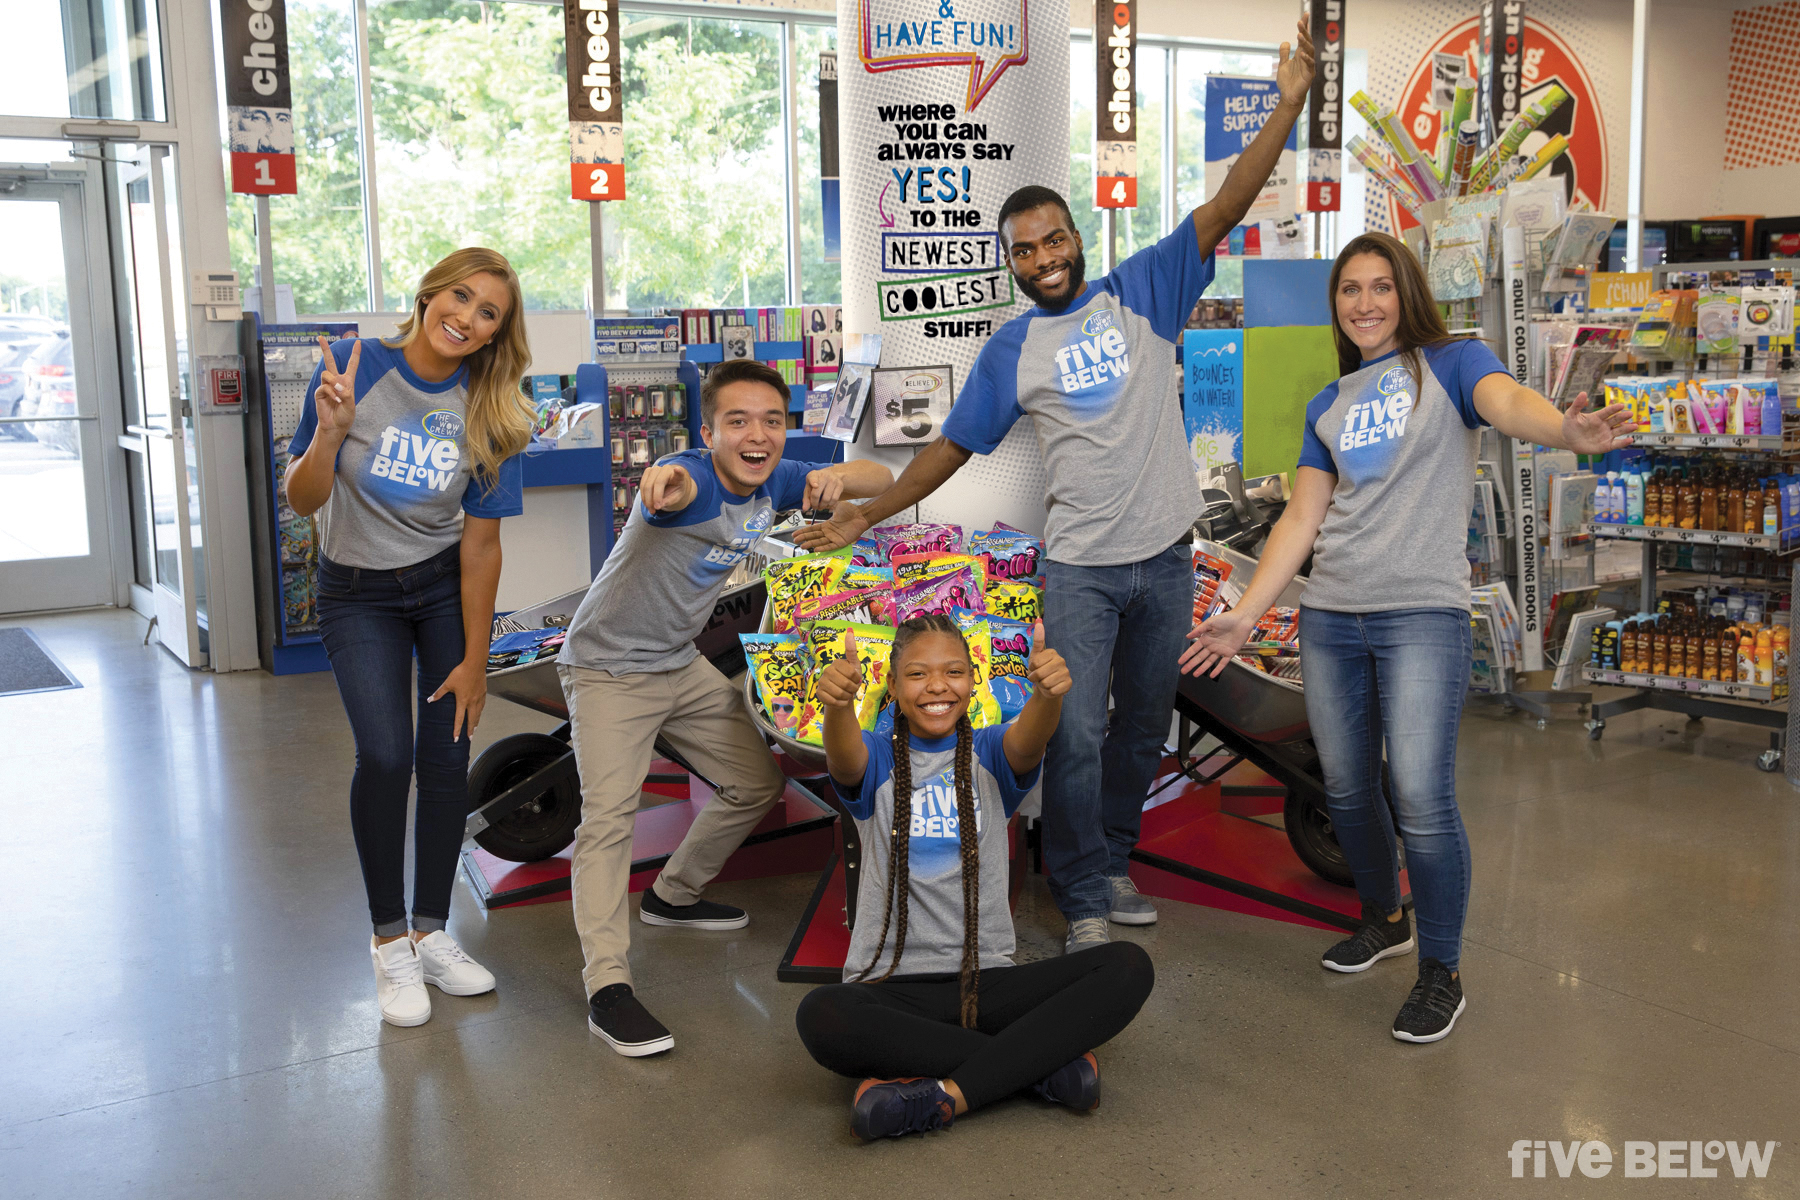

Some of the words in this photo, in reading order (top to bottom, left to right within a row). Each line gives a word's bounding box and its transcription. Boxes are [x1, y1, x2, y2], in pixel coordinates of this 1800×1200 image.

[876, 21, 943, 49] HAVE
[953, 21, 1014, 49] FUN!
[1108, 0, 1131, 133] checko
[1319, 0, 1341, 141] checkou
[1498, 1, 1521, 130] heckout
[1224, 95, 1260, 114] HELP
[1262, 93, 1280, 110] US
[1223, 111, 1273, 132] SUPPO
[255, 159, 276, 186] 1
[590, 169, 609, 194] 2
[892, 165, 971, 204] YES!
[1111, 181, 1127, 203] 4
[1319, 186, 1332, 206] 5
[910, 210, 936, 227] TO
[892, 241, 991, 265] NEWEST
[886, 276, 1000, 313] COOLEST
[1089, 313, 1102, 325] THE
[1095, 314, 1111, 326] WOW
[727, 340, 747, 358] $3
[1055, 328, 1126, 375] five
[1515, 325, 1528, 388] COLORiN
[217, 371, 238, 379] FIRE
[1061, 354, 1130, 393] BELOW
[1192, 363, 1234, 385] BOUNCES
[1387, 370, 1400, 378] THE
[836, 376, 863, 430] $1
[1192, 388, 1205, 407] ON
[1206, 388, 1235, 408] WATER!
[434, 413, 450, 422] THE
[885, 398, 933, 438] $5
[1345, 391, 1412, 433] five
[429, 425, 457, 436] CREW!
[439, 420, 460, 431] WOW
[1340, 416, 1407, 452] BELOW
[380, 425, 460, 471] five
[370, 454, 454, 492] BELOW
[704, 545, 750, 567] BEL
[977, 546, 1040, 580] olli
[776, 570, 822, 600] SOUR
[774, 585, 827, 614] PATCH
[819, 592, 865, 618] RESEALABLE
[1008, 604, 1034, 620] UR
[1525, 585, 1537, 632] BOOKS
[702, 592, 751, 634] LOW
[991, 634, 1028, 653] olli
[767, 662, 804, 680] SOU
[990, 654, 1008, 664] OUR
[767, 675, 806, 695] PAT
